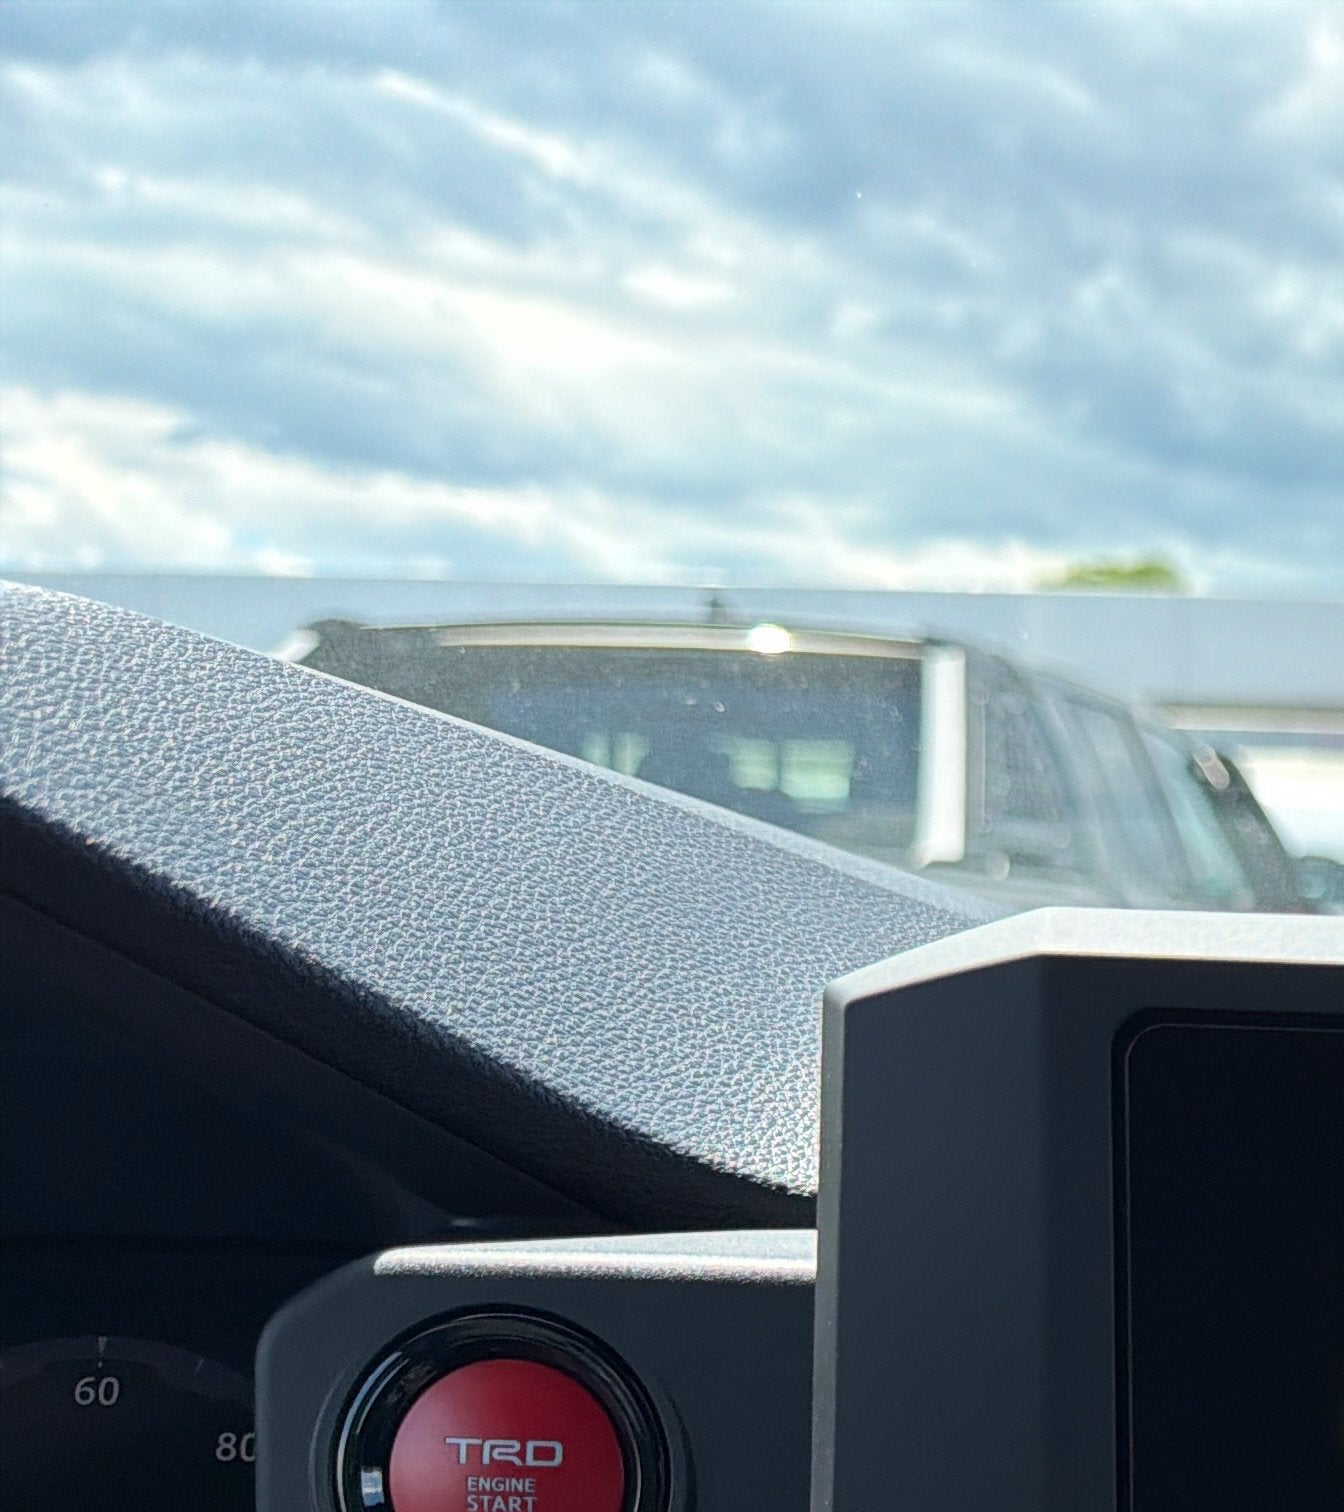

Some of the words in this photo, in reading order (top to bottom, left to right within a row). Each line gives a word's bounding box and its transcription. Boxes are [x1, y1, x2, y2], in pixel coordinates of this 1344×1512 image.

[75, 1376, 120, 1406] 60
[215, 1432, 256, 1462] 80
[445, 1437, 564, 1467] TRD
[467, 1476, 536, 1493] ENGINE
[467, 1495, 537, 1512] START
